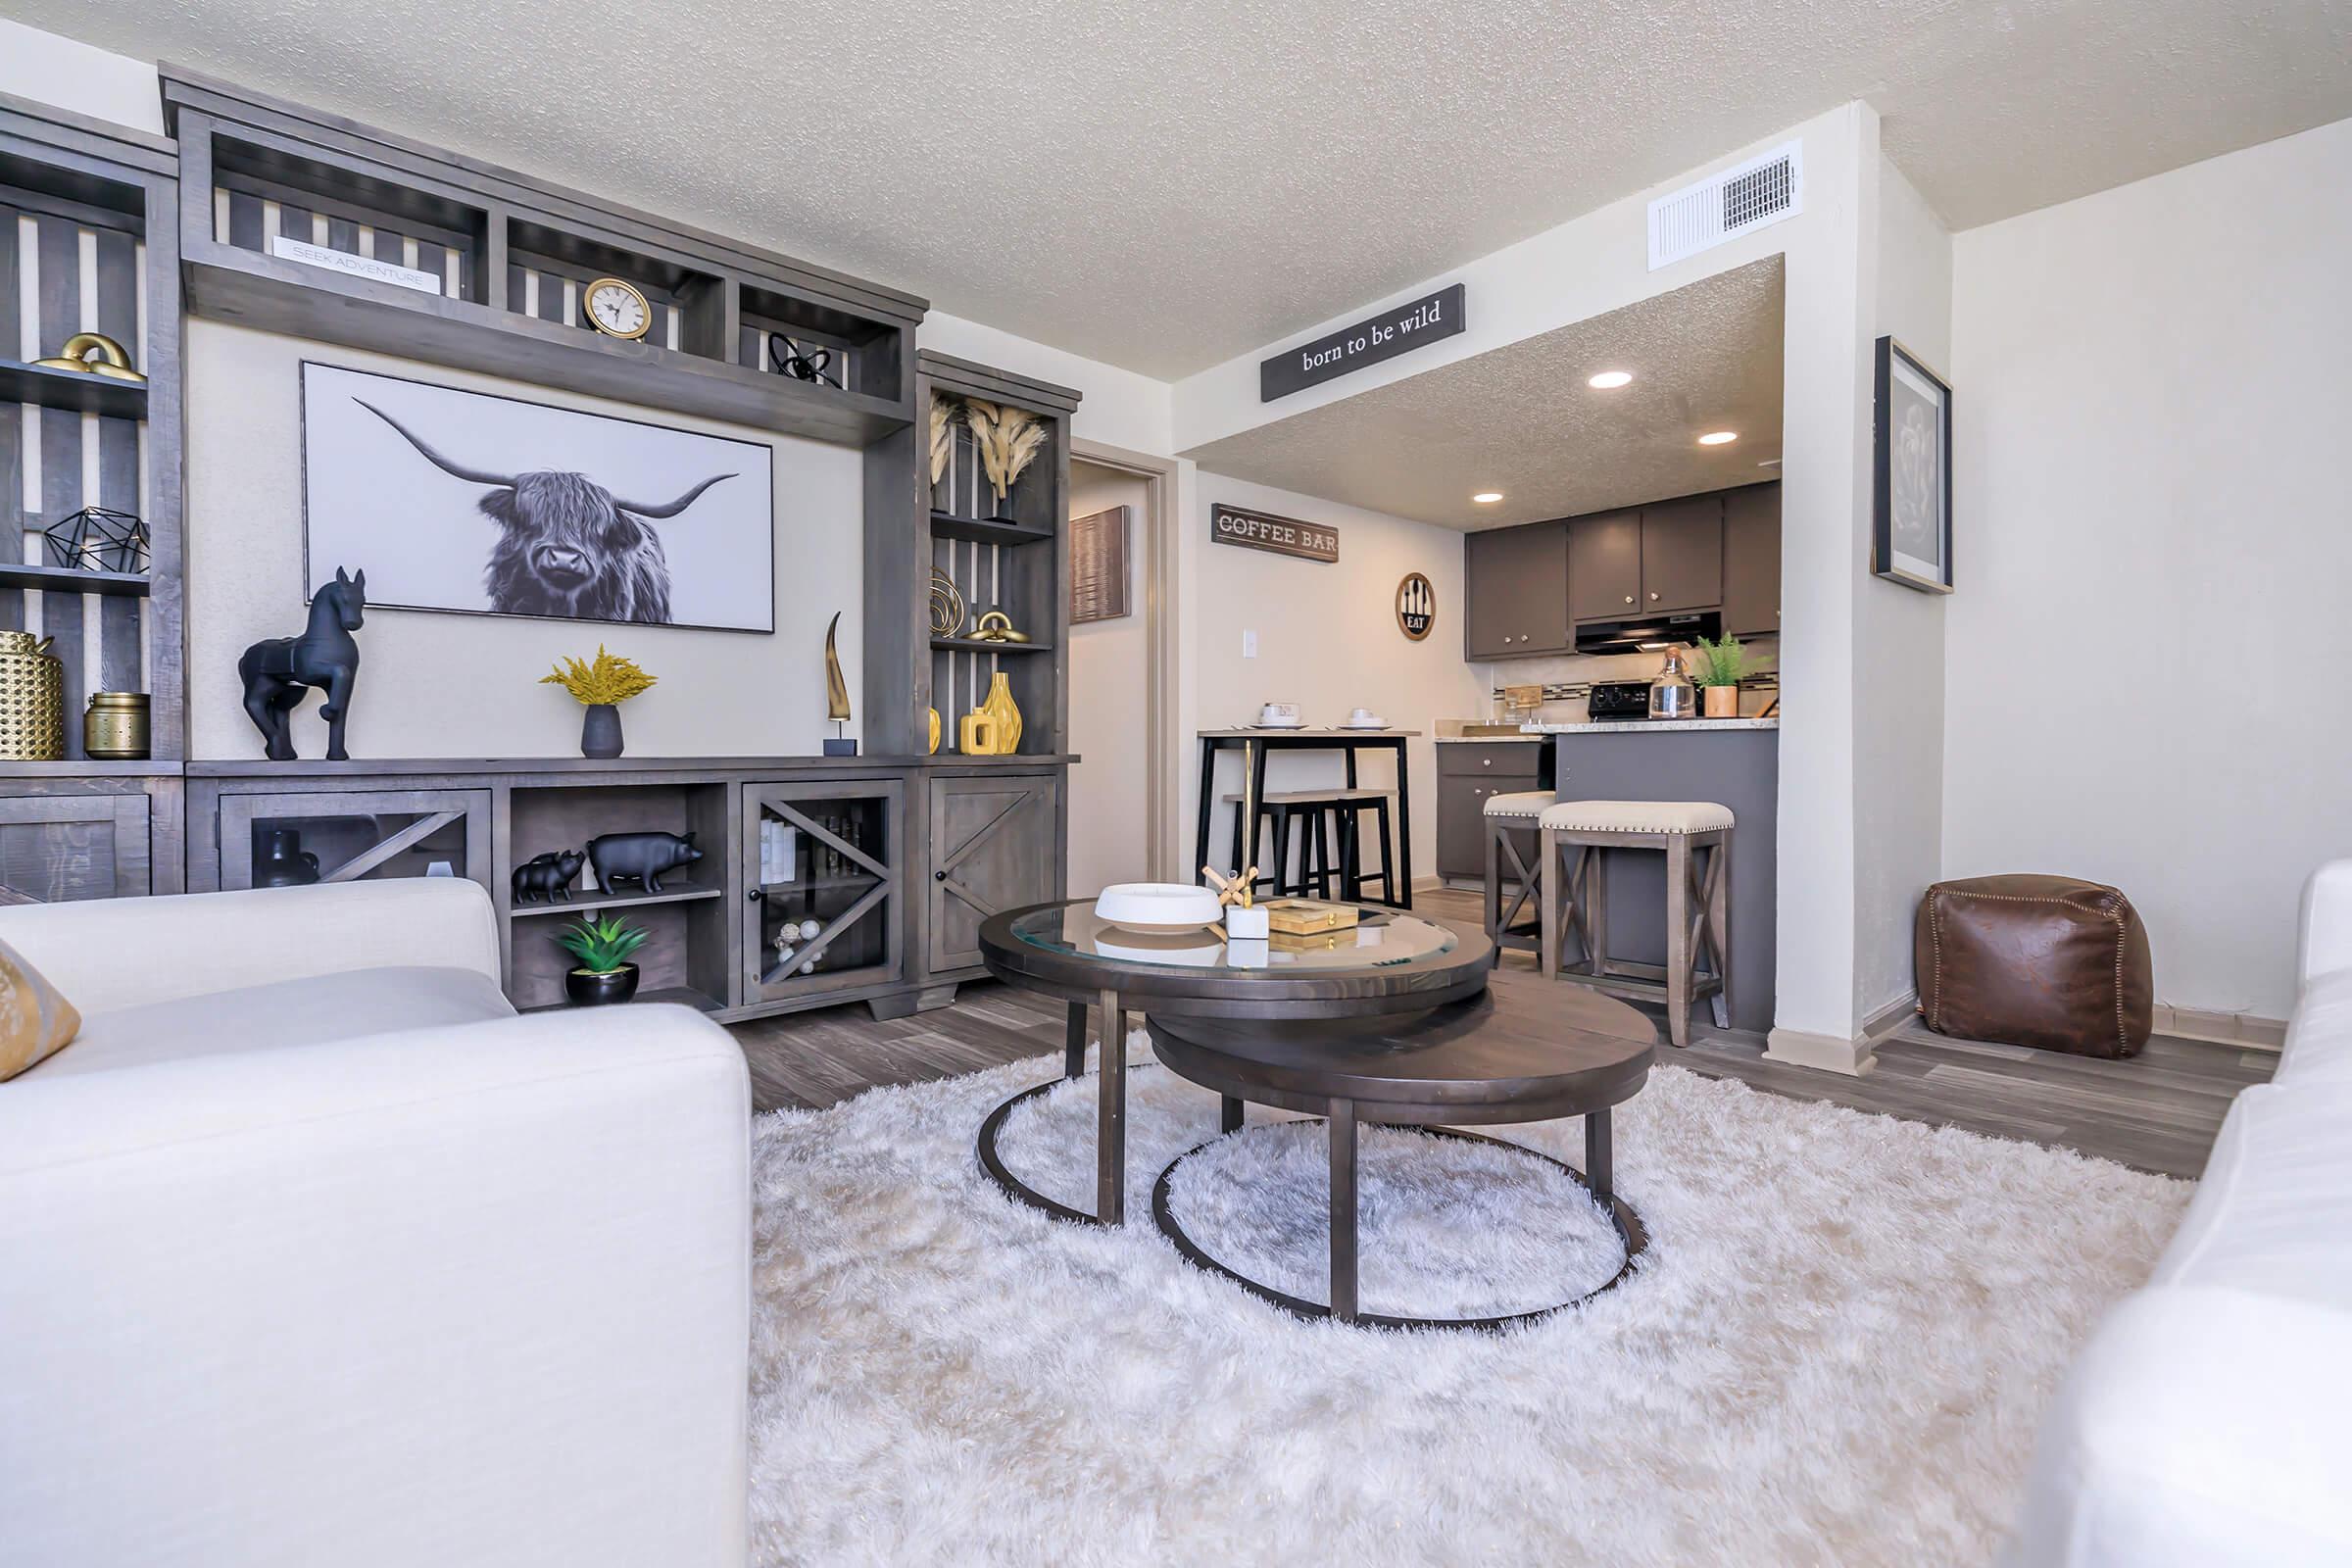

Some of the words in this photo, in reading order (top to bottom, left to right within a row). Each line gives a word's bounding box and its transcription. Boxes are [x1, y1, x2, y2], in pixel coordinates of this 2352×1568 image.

[293, 246, 332, 263] SEEK
[336, 257, 424, 286] ADVENTURE
[1302, 345, 1343, 371] born
[1348, 337, 1366, 355] to
[1371, 325, 1394, 346] be
[1399, 300, 1443, 335] wild
[1219, 514, 1296, 544] COFFEE
[1301, 530, 1339, 552] BAR
[1407, 615, 1425, 629] EAT
